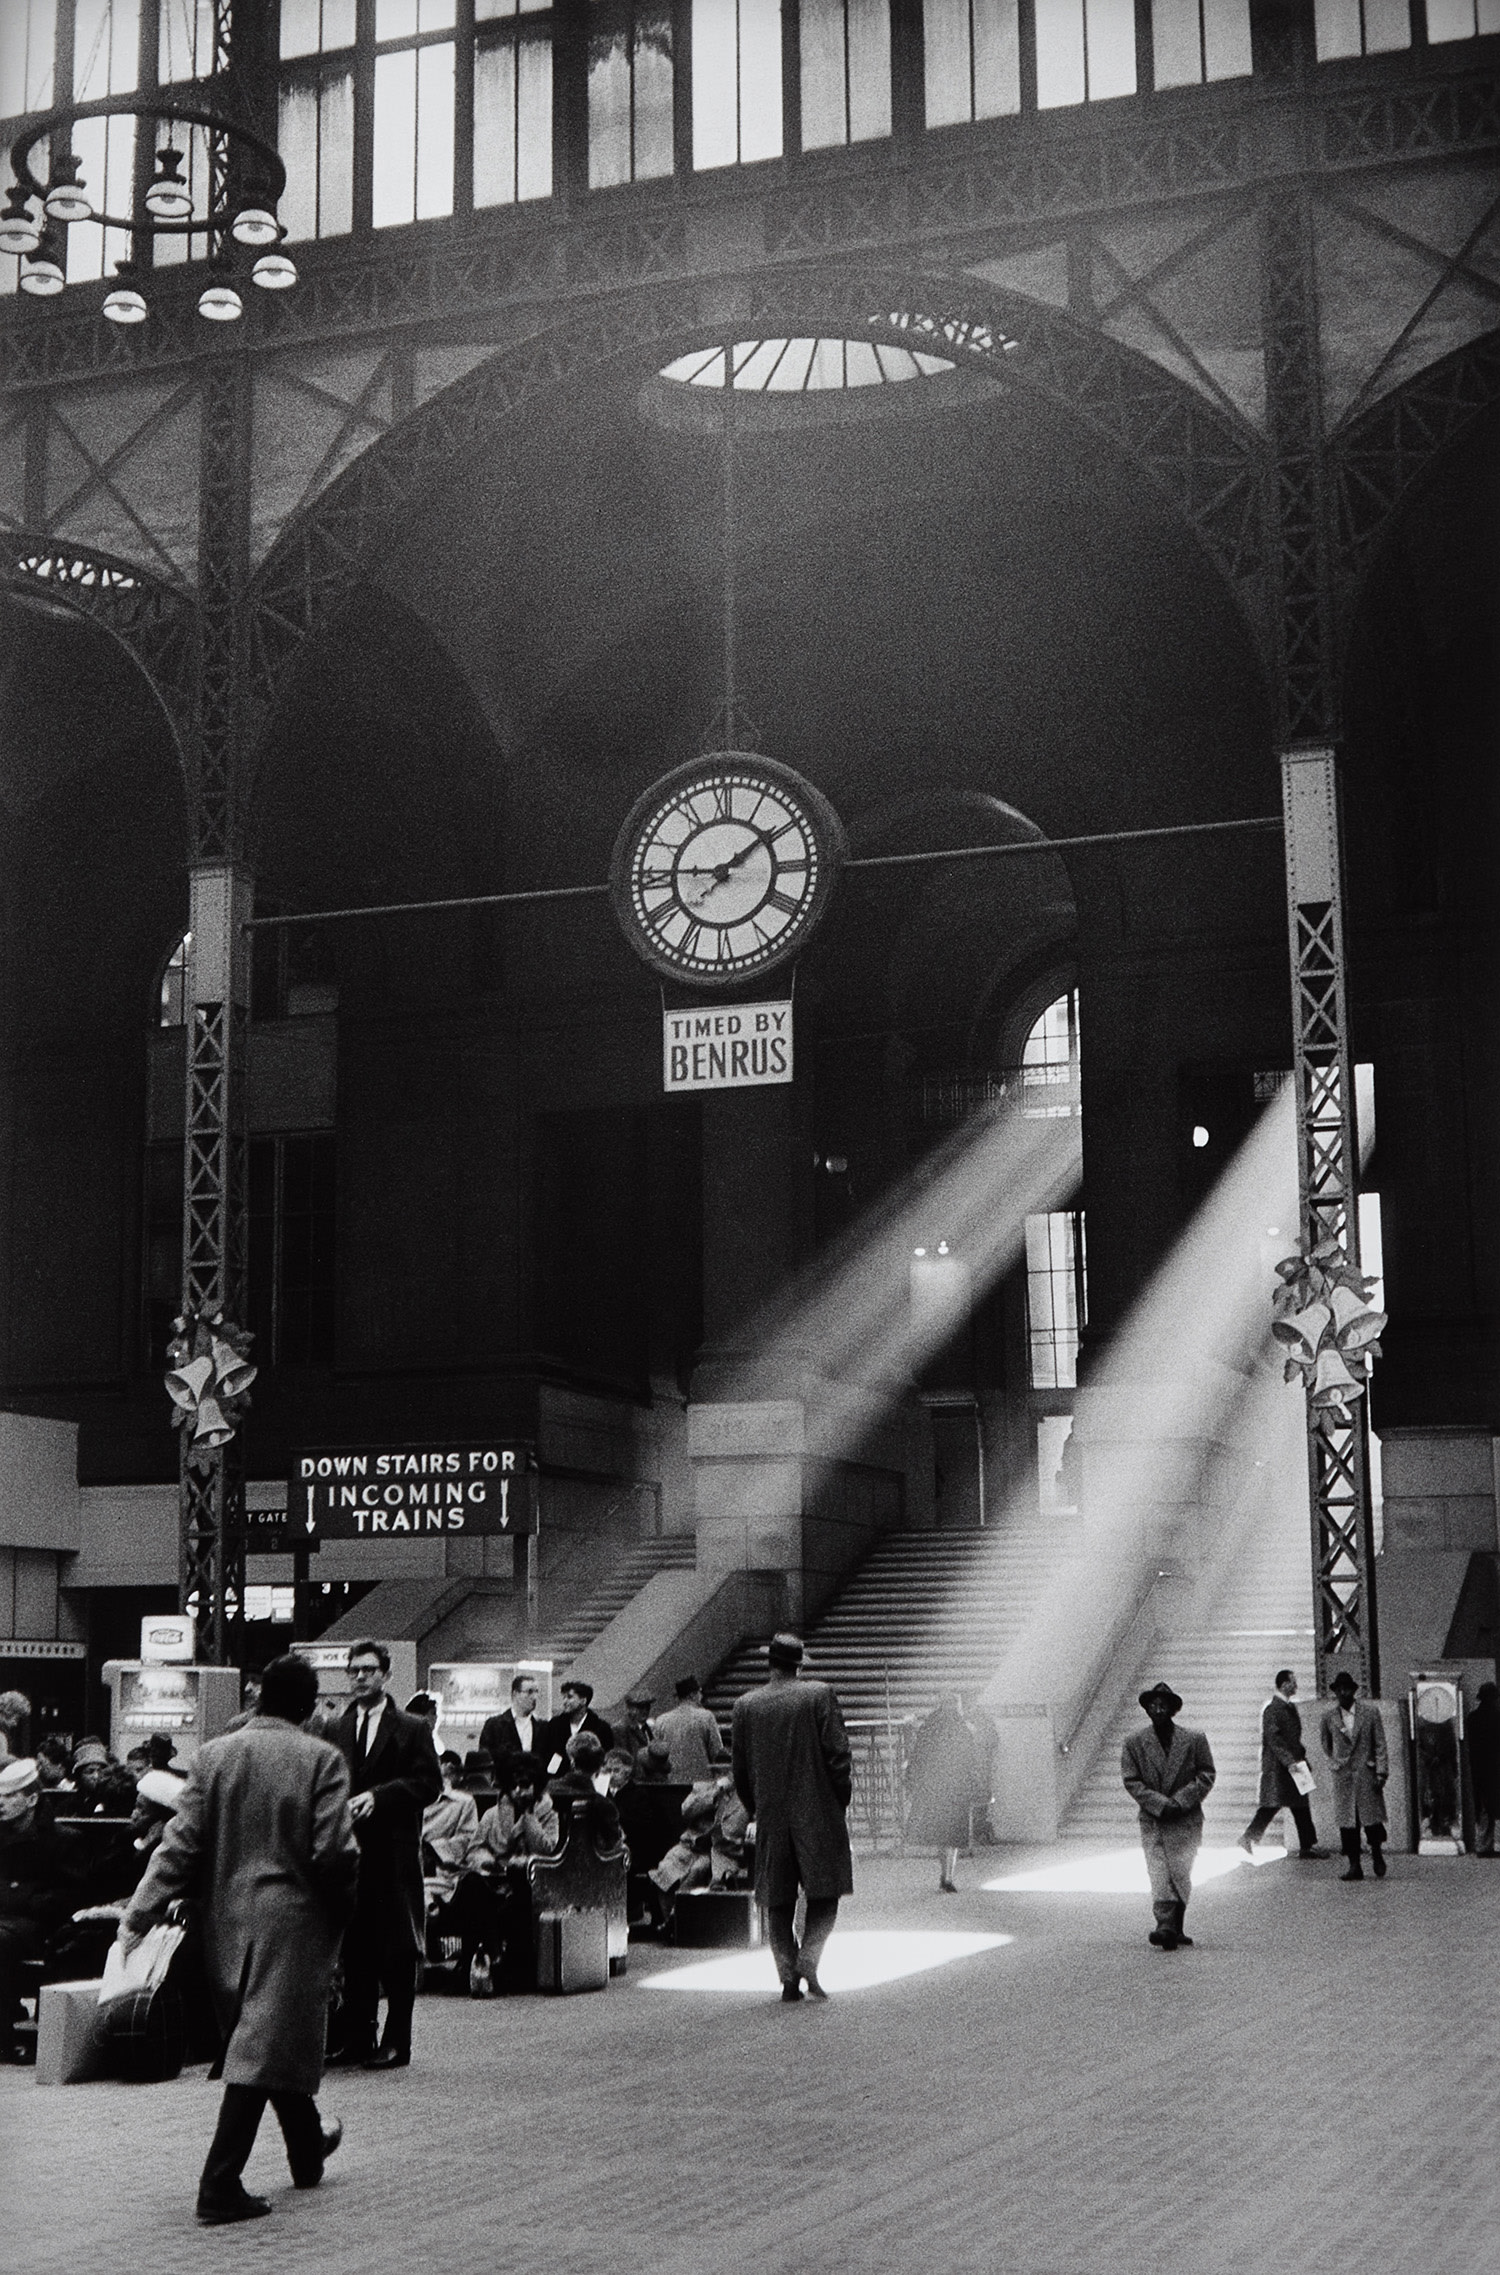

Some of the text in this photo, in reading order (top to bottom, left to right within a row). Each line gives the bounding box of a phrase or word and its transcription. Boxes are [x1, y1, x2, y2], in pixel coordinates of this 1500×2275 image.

[671, 1011, 786, 1039] TIMED BY
[671, 1036, 788, 1082] BENRUS
[301, 1450, 516, 1477] DOWN STAIRS FOR
[328, 1481, 487, 1507] INCOMING
[258, 1512, 288, 1524] GATE
[353, 1507, 465, 1532] TRAINS
